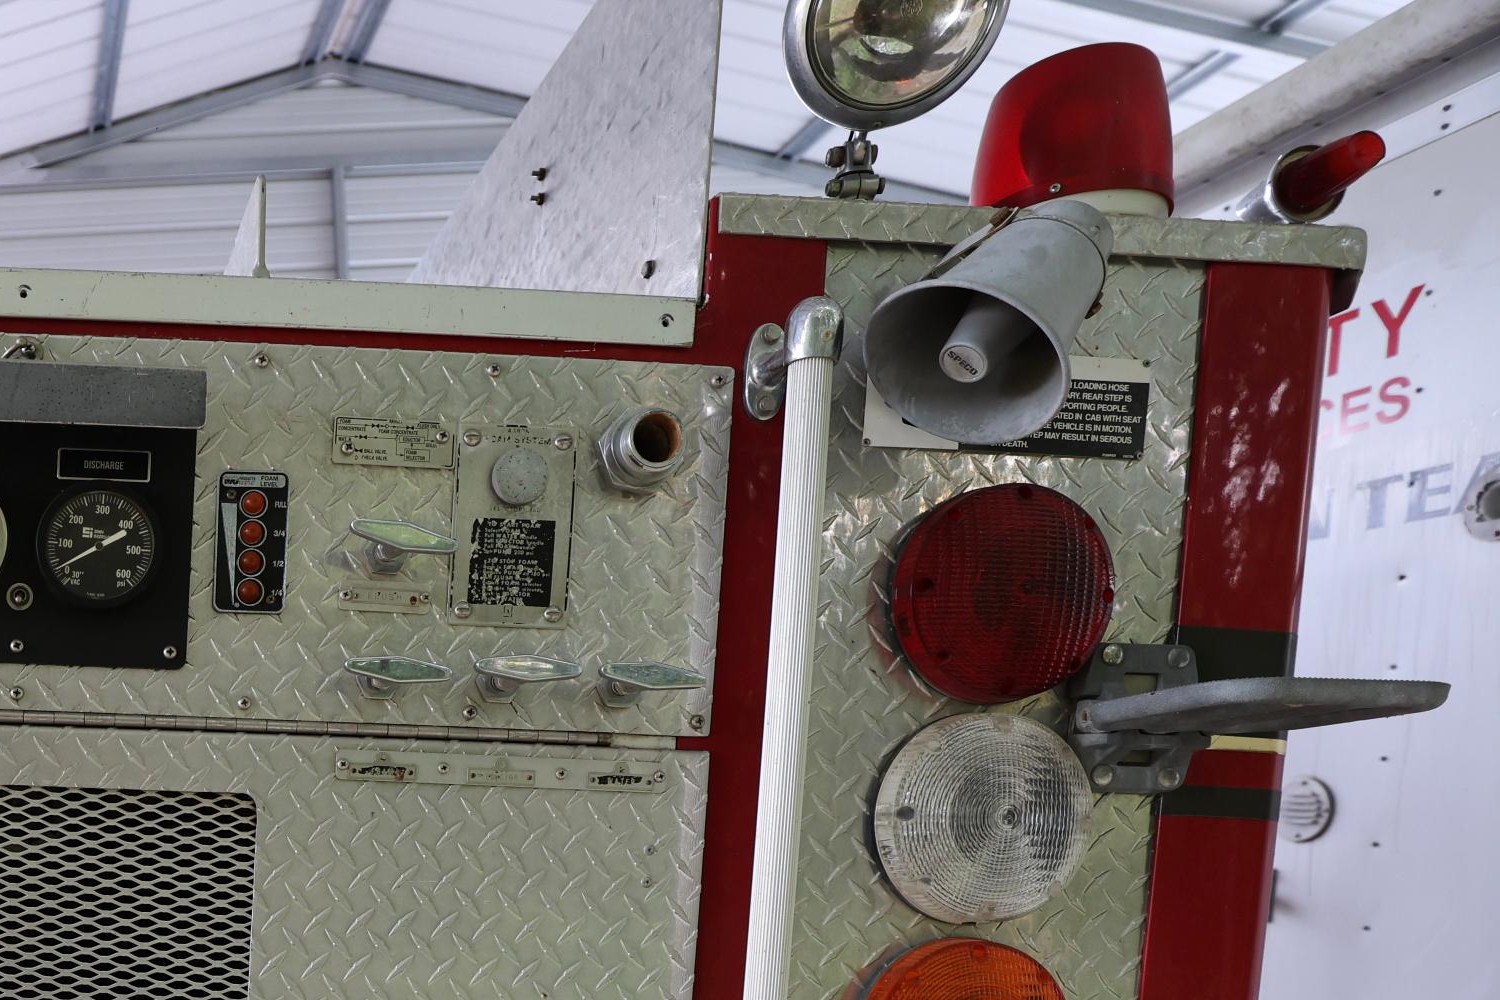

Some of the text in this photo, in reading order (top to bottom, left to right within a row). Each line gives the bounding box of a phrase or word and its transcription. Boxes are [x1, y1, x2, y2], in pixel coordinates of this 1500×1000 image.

[948, 351, 978, 375] SPECO
[1074, 382, 1129, 392] LOADING HOSE
[1104, 394, 1124, 402] STEP
[1097, 404, 1128, 412] PEOPLE.
[1053, 422, 1084, 430] VEHICLE
[1102, 425, 1132, 433] MOTION.
[1062, 433, 1090, 441] RESULT
[1100, 436, 1132, 444] SERIOUS
[84, 460, 124, 470] DISCHARGE
[96, 505, 110, 514] 300
[69, 515, 84, 524] 200
[119, 520, 133, 529] 400
[58, 539, 72, 548] 100
[126, 545, 140, 554] 500
[65, 566, 70, 574] 0
[116, 569, 131, 578] 600
[117, 579, 126, 588] psi
